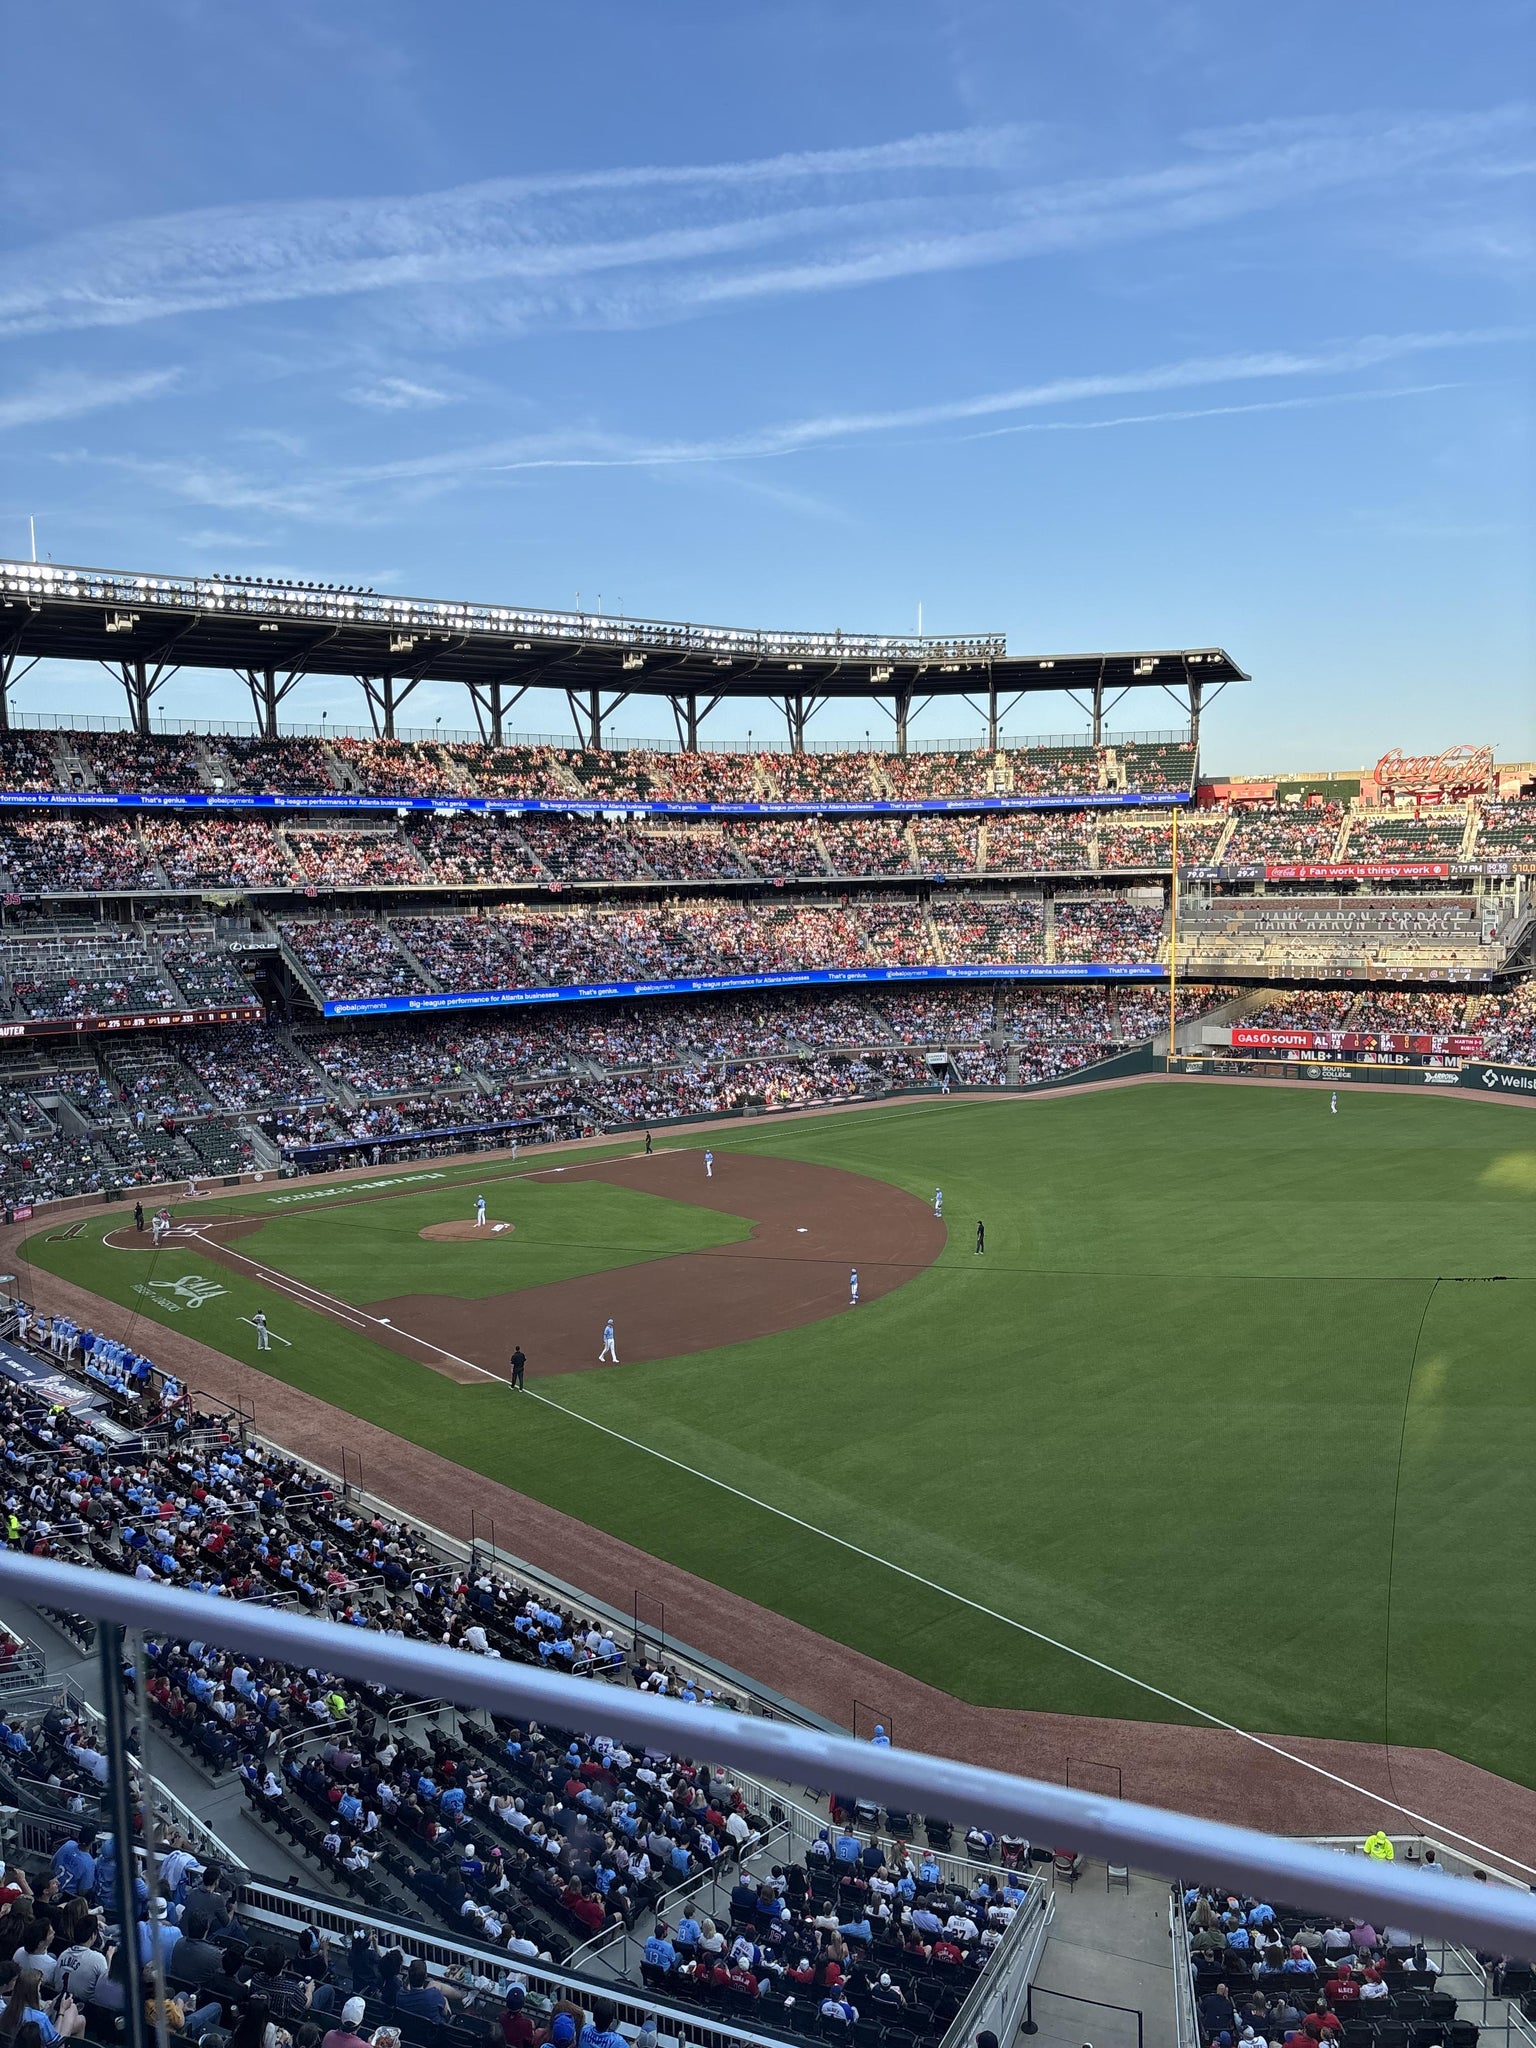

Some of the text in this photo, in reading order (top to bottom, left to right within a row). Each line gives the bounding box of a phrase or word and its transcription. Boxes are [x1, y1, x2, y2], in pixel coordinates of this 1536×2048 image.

[1374, 744, 1498, 786] Coca-Cola
[1368, 867, 1400, 875] thirsty
[304, 886, 317, 897] 41
[549, 882, 562, 892] 44
[3, 894, 21, 905] 35
[1255, 912, 1463, 930] HANK AARON TERRACE
[692, 981, 720, 990] Big-league
[722, 979, 755, 988] performance
[598, 988, 619, 996] genius.
[409, 999, 446, 1008] Big-league
[447, 996, 490, 1006] performance
[525, 992, 559, 1000] businesses
[1238, 1034, 1306, 1044] GAS SOUTH
[1314, 1036, 1328, 1045] AL
[1301, 1050, 1332, 1060] MLB+
[1378, 1054, 1410, 1064] MLB+
[598, 1743, 609, 1753] 27
[840, 1847, 848, 1858] 3
[57, 1865, 74, 1889] 27
[923, 1869, 931, 1881] 3
[649, 1951, 659, 1964] 13
[60, 1957, 80, 1970] ALBIES
[584, 2031, 615, 2048] MURPHY
